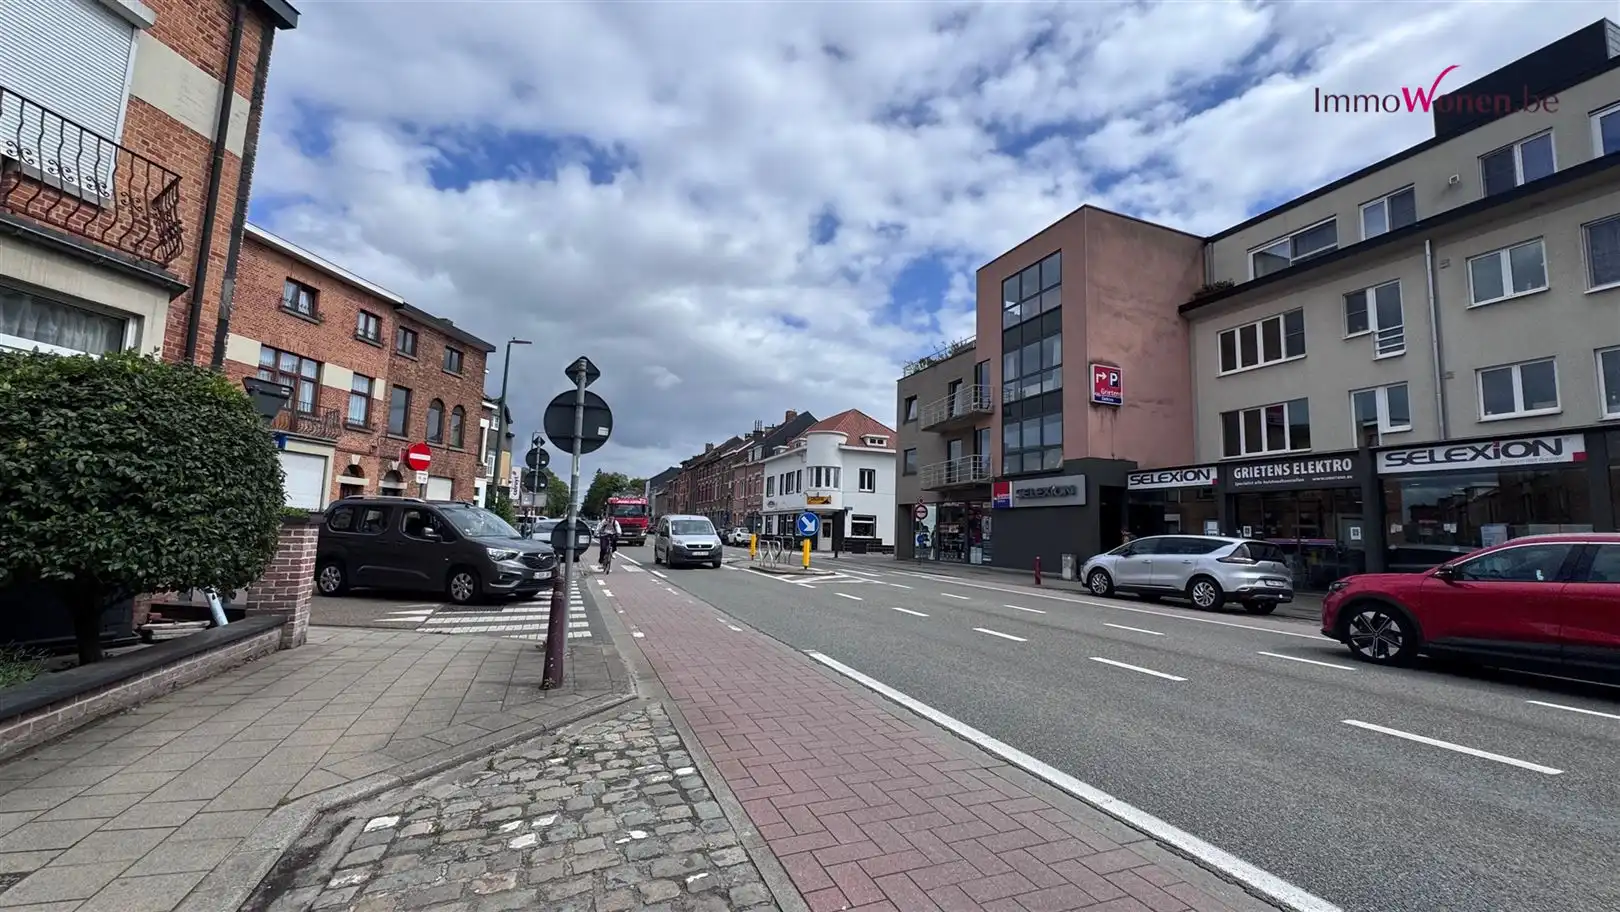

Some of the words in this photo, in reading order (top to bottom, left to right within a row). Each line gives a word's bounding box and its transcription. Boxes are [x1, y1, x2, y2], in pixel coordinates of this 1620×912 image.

[1110, 372, 1118, 386] P
[1233, 463, 1290, 479] GRIETENS
[1293, 458, 1352, 475] ELEKTRO
